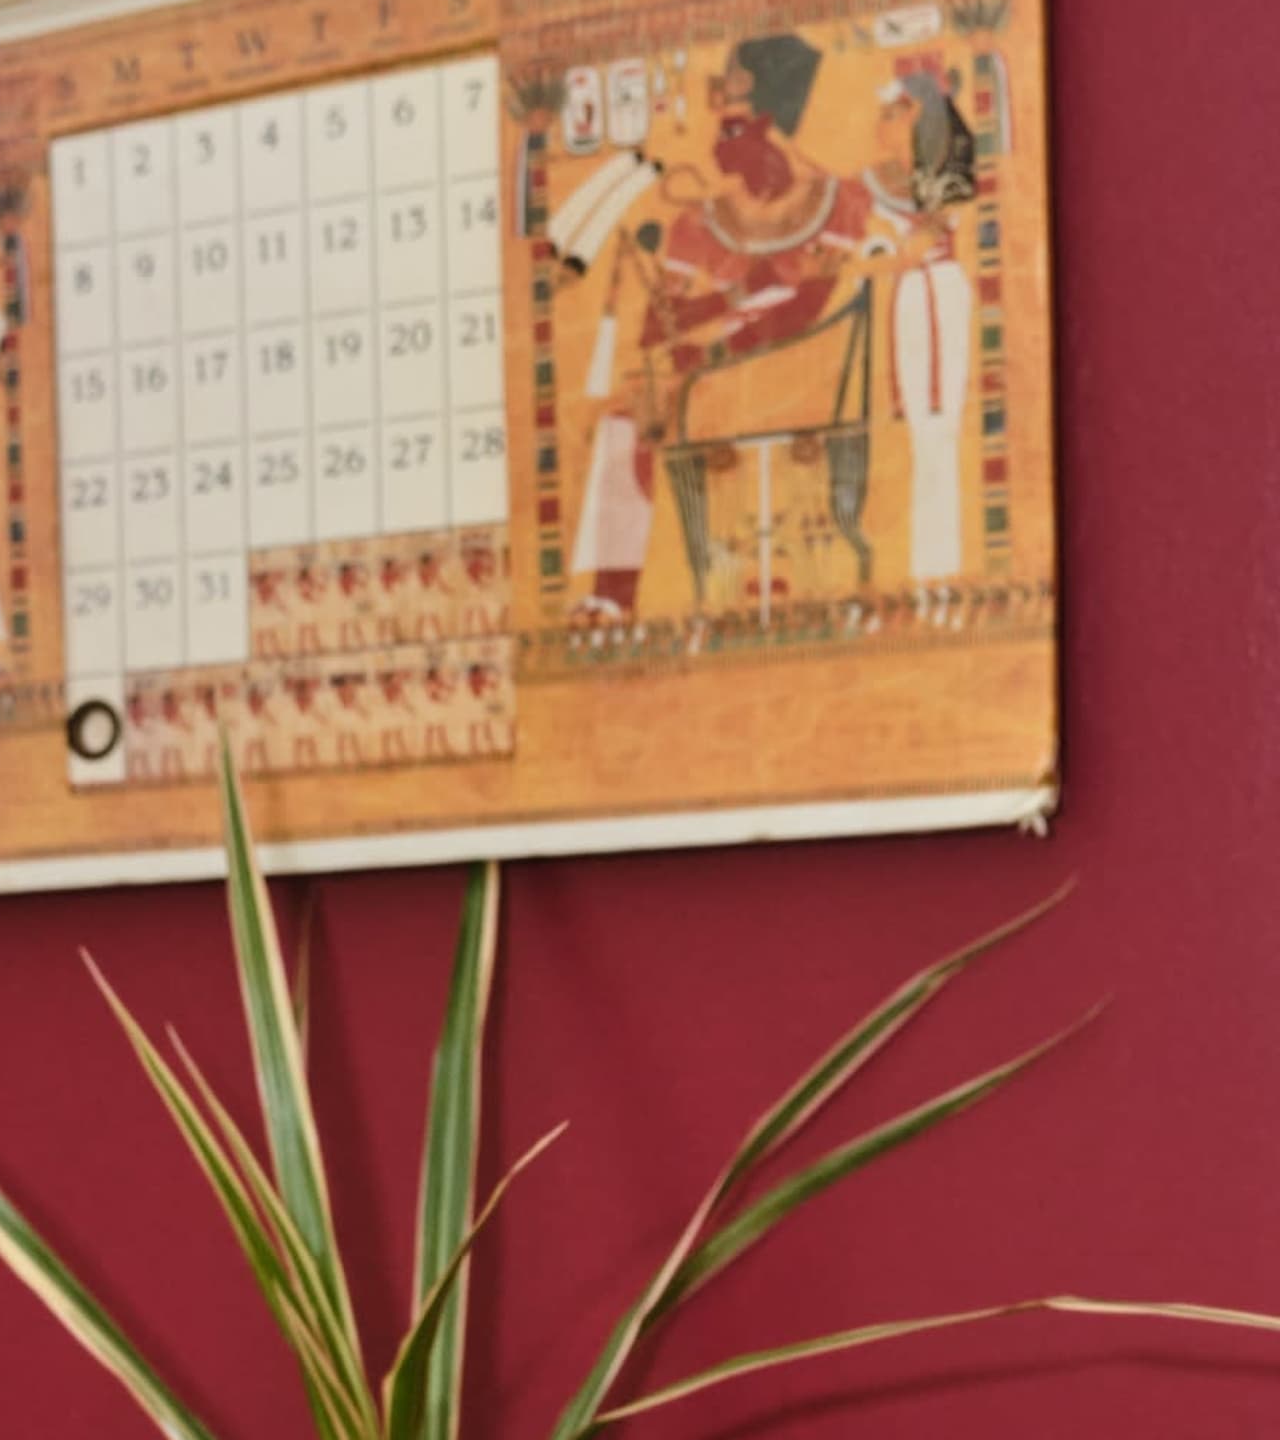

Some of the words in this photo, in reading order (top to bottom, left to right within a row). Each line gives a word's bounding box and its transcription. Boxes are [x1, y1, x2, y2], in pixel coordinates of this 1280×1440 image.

[112, 55, 143, 85] M
[177, 39, 199, 71] T
[235, 27, 268, 57] W
[309, 10, 332, 42] T
[71, 155, 87, 189] 1
[132, 143, 151, 177] 2
[196, 130, 216, 164] 3
[260, 119, 280, 151] 4
[324, 103, 348, 141] 5
[391, 97, 417, 127] 6
[464, 79, 485, 112] 7
[73, 265, 93, 293] 8
[132, 252, 156, 279] 9
[191, 239, 229, 277] 10
[257, 230, 287, 265] 11
[322, 215, 358, 254] 12
[390, 205, 428, 243] 13
[461, 196, 498, 230] 14
[70, 367, 107, 404] 15
[132, 364, 169, 393] 16
[194, 348, 230, 385] 17
[260, 340, 295, 374] 18
[324, 330, 363, 366] 19
[388, 319, 433, 358] 20
[460, 310, 498, 347] 21
[69, 477, 109, 511] 22
[131, 466, 171, 503] 23
[194, 460, 233, 494] 24
[257, 450, 300, 487] 25
[323, 445, 367, 479] 26
[389, 433, 433, 471] 27
[461, 425, 506, 461] 28
[74, 585, 112, 618] 29
[135, 576, 174, 609] 30
[196, 569, 231, 603] 31
